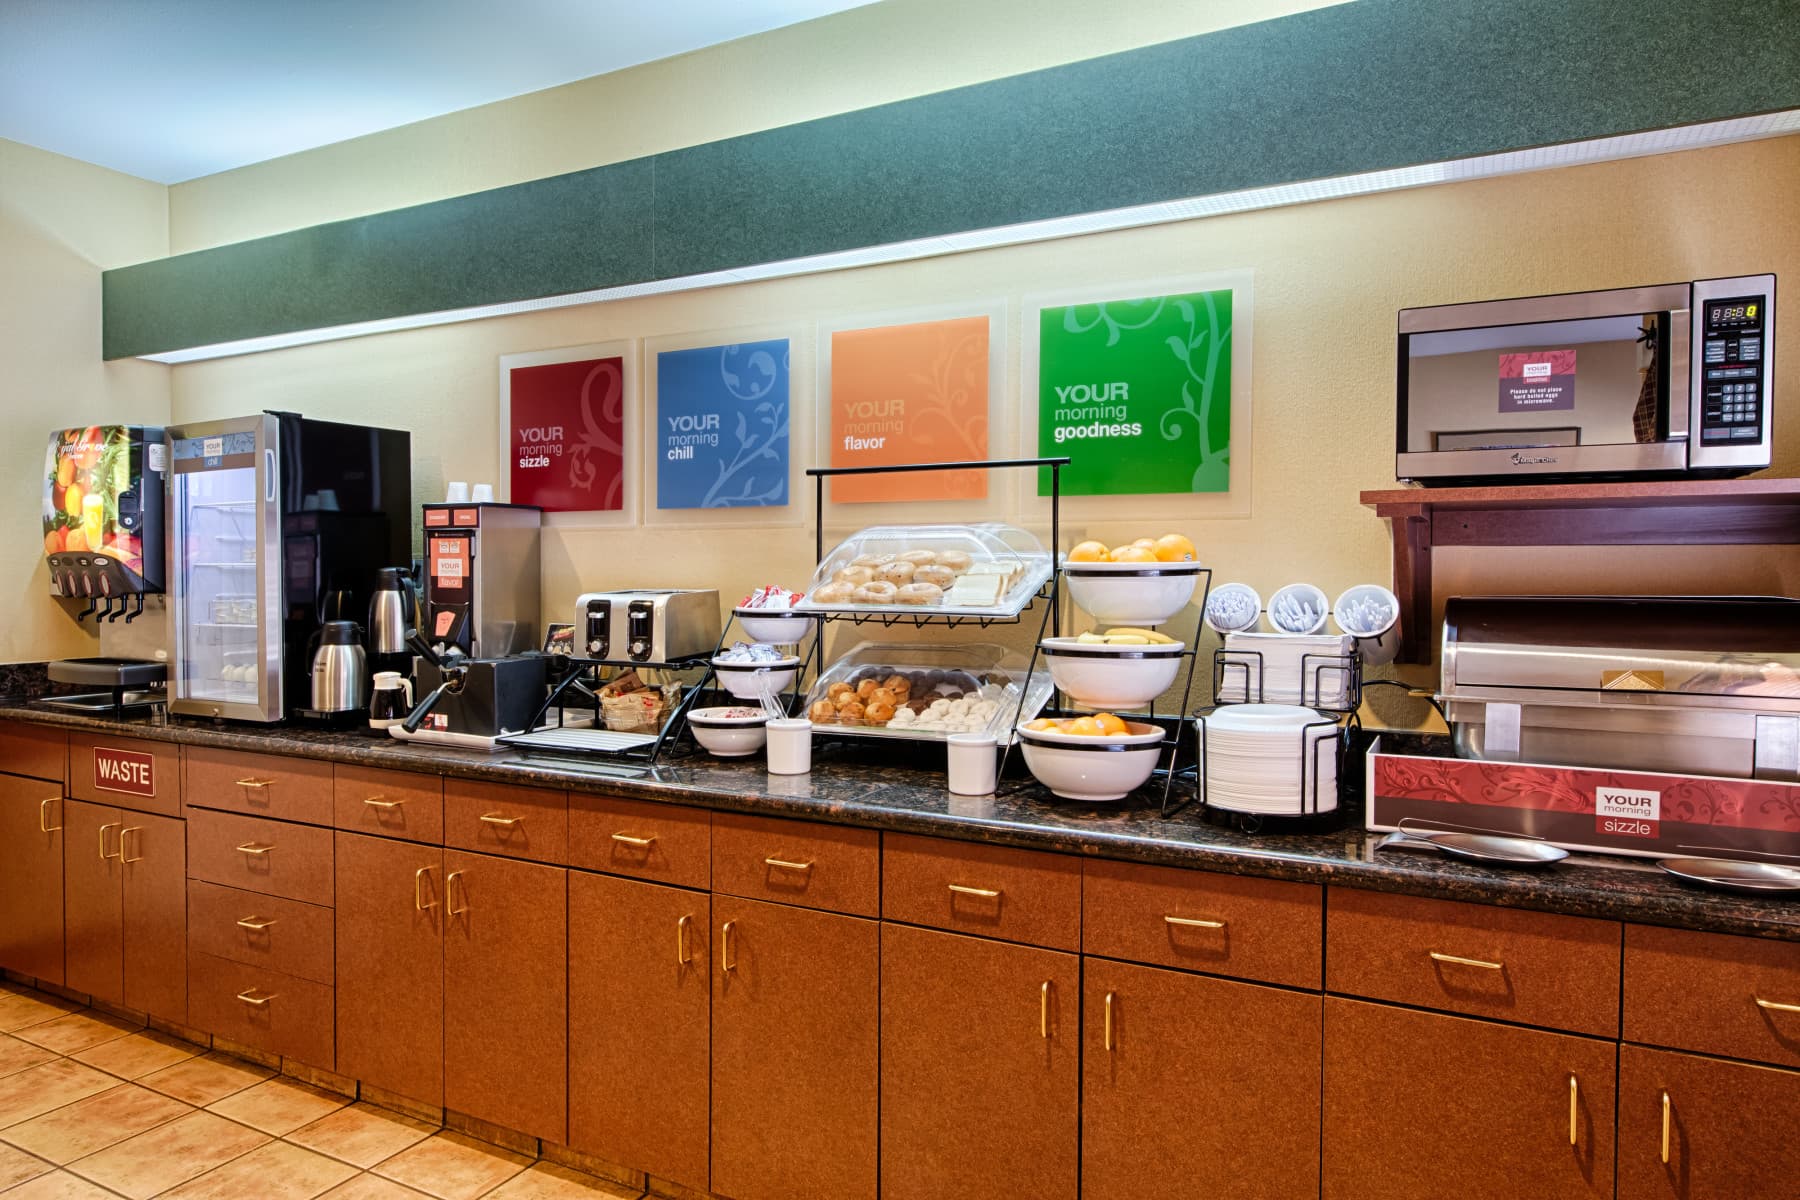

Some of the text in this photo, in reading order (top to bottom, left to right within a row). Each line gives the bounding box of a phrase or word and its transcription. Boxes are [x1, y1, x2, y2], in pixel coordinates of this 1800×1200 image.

[1054, 382, 1128, 404] YOUR
[844, 400, 904, 418] YOUR
[1055, 403, 1127, 421] morning
[668, 414, 719, 431] YOUR
[844, 419, 904, 435] morning
[519, 426, 563, 442] YOUR
[668, 432, 719, 447] morning
[1054, 421, 1142, 443] goodness
[520, 443, 562, 457] morning
[844, 435, 886, 451] flavor
[668, 446, 693, 460] chill
[519, 455, 550, 468] sizzle
[441, 562, 460, 570] YOUR
[98, 758, 150, 785] WASTE
[1604, 794, 1652, 807] YOUR
[1604, 805, 1651, 817] morning
[1604, 818, 1651, 835] sizzle
